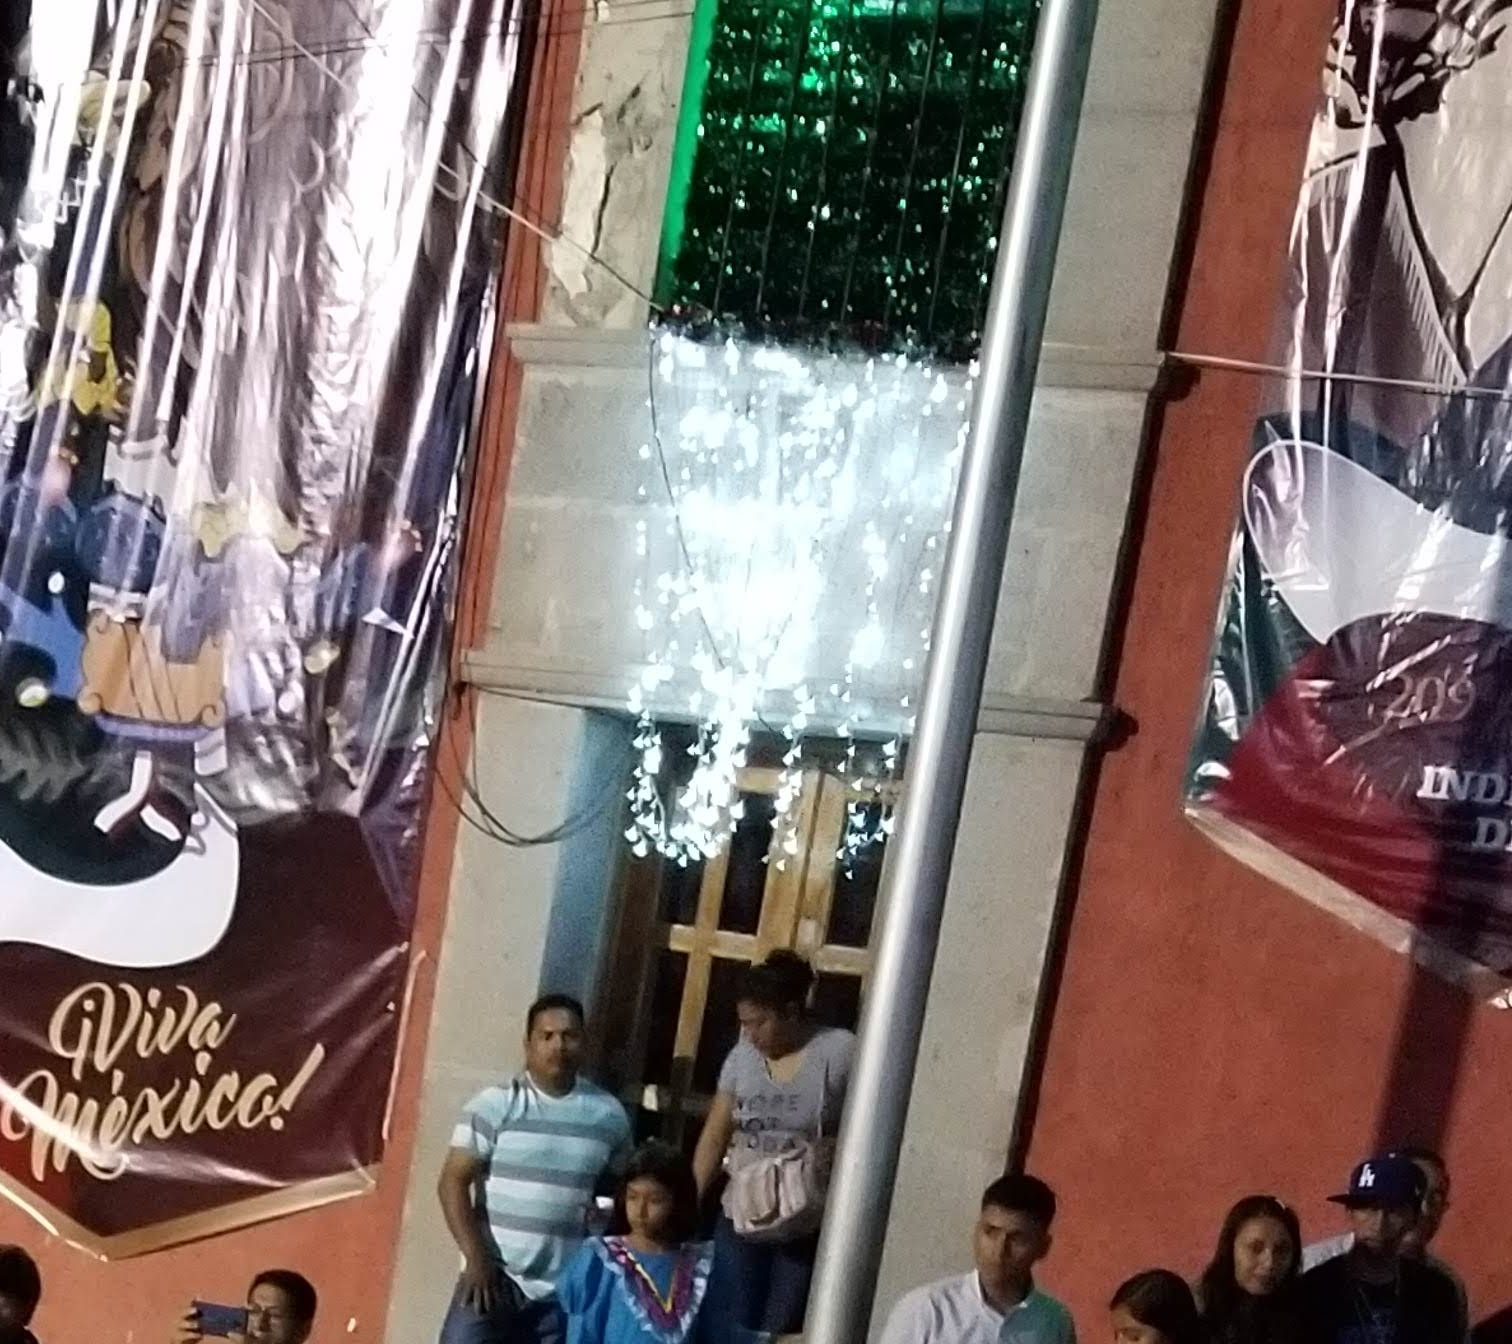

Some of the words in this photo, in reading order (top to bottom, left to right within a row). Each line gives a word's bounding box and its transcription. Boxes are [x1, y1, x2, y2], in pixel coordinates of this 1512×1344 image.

[1472, 815, 1512, 853] D
[49, 982, 237, 1080] ¡Viva
[0, 1042, 326, 1182] México!
